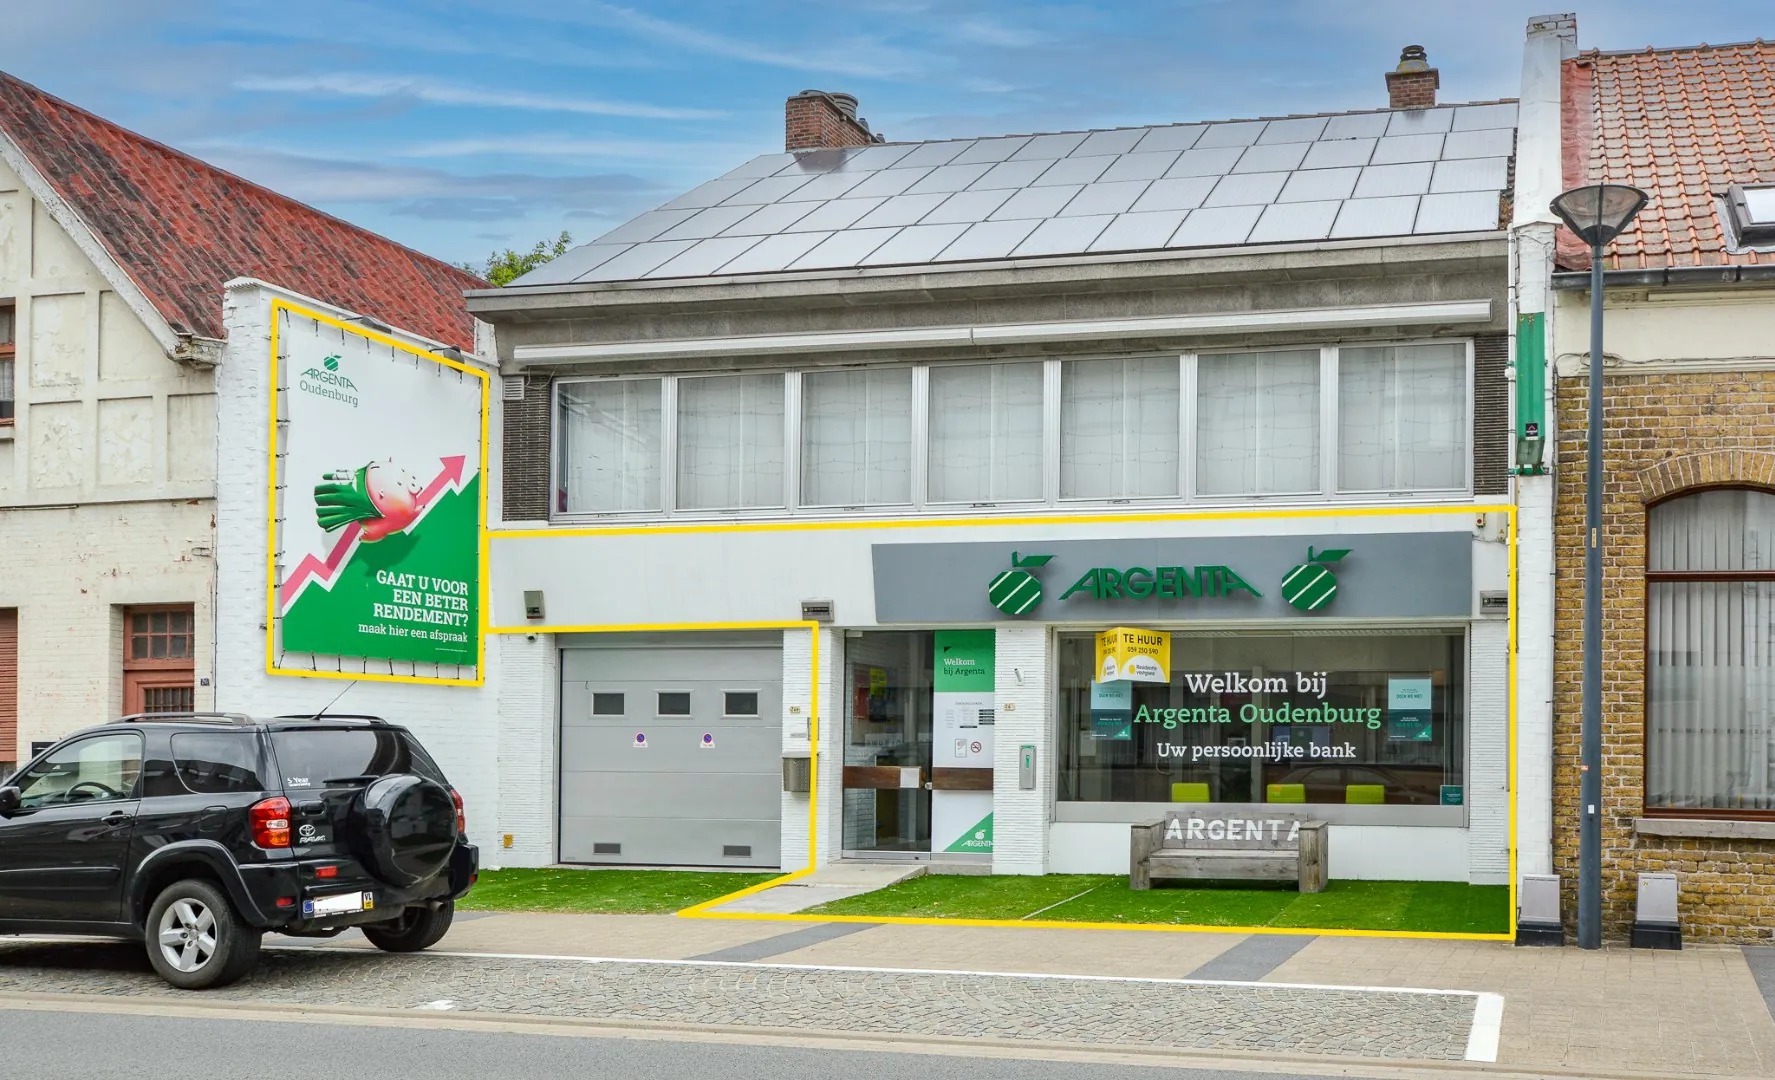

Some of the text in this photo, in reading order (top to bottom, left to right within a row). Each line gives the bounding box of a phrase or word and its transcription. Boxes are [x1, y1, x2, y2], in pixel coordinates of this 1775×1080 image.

[300, 368, 358, 392] ARGENTA
[300, 380, 358, 408] Oudenburg
[376, 569, 469, 596] GAAT U VOOR
[1058, 565, 1265, 601] ARGENTA
[392, 588, 469, 612] EEN BETER
[373, 602, 469, 627] RENDEMENT?
[358, 623, 468, 643] maak hier een afspraak
[1123, 633, 1163, 646] TE HUUR
[943, 658, 975, 666] Welkom
[943, 667, 985, 677] bij Argenta
[1184, 671, 1328, 699] Welkom bij
[1133, 702, 1382, 730] Argenta Oudenburg
[1156, 742, 1357, 762] Uw persoonlijke bank
[1165, 818, 1301, 841] ARGENTA
